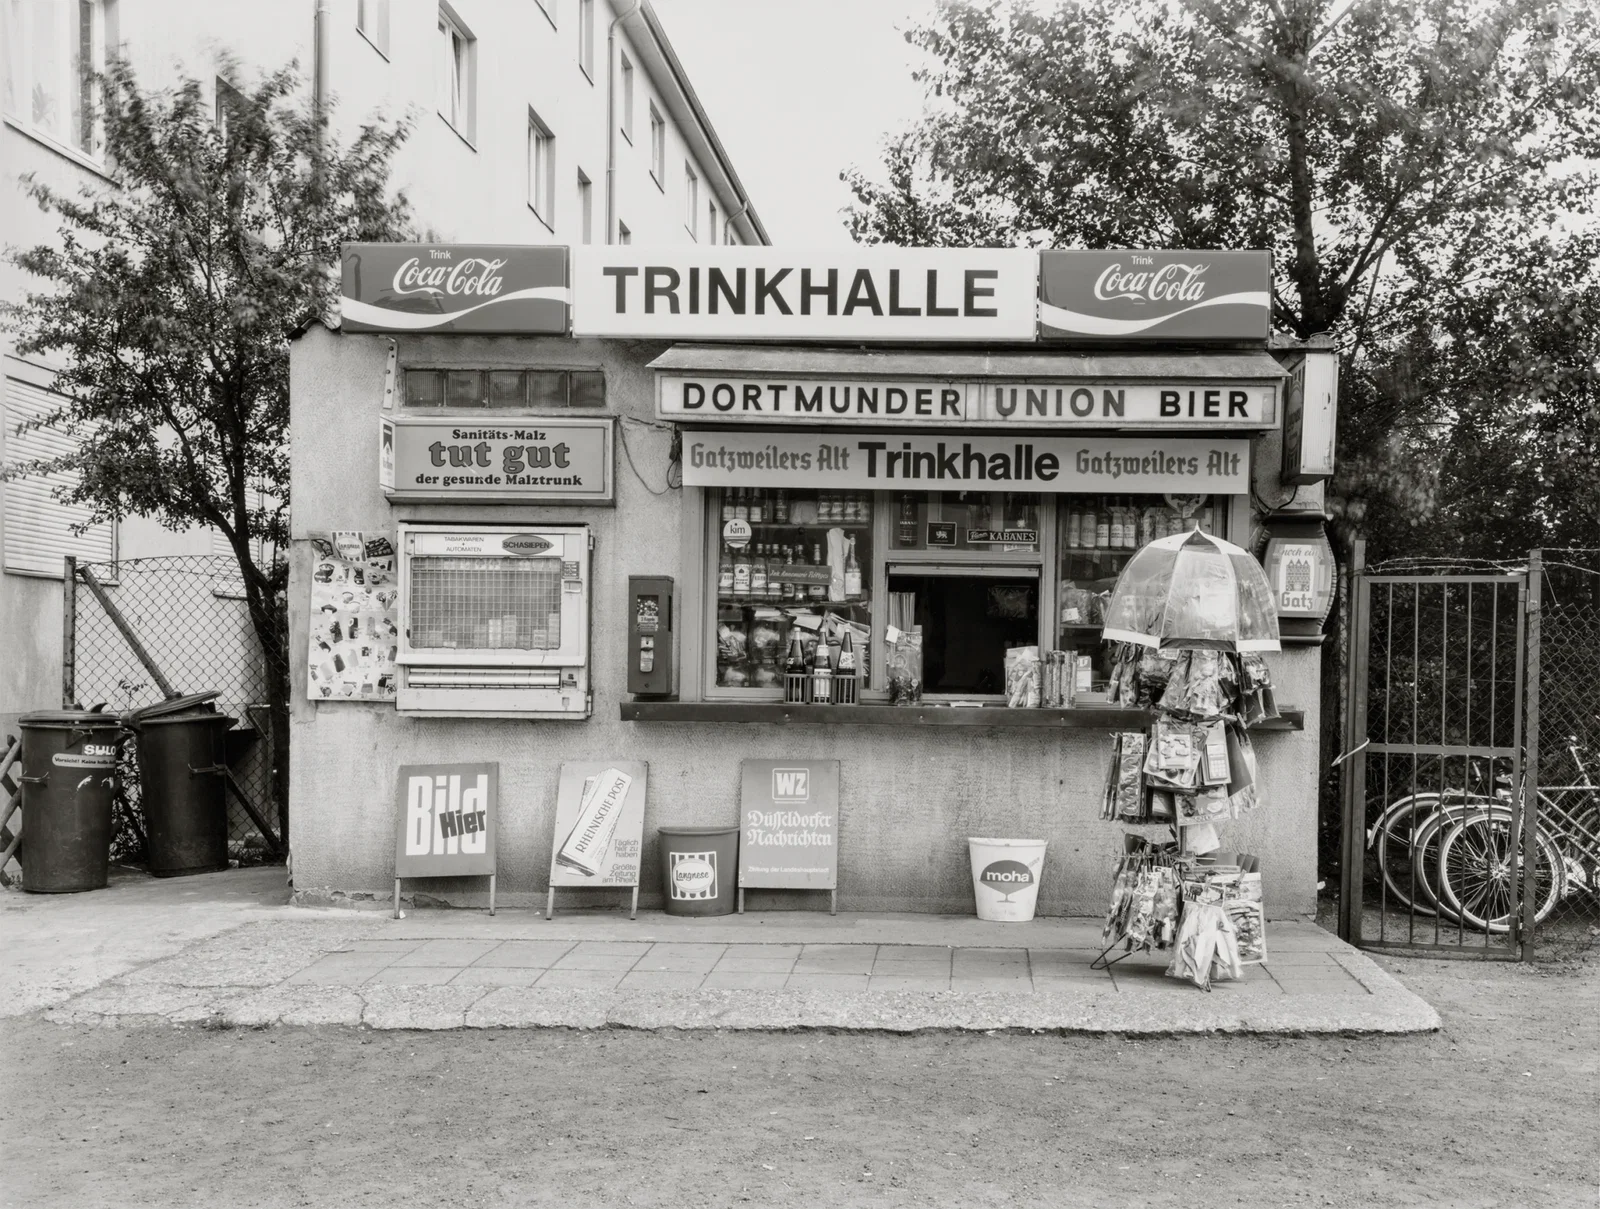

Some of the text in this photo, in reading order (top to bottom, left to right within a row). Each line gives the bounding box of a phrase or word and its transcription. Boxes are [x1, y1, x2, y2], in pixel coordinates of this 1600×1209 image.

[429, 250, 451, 259] Trink
[1131, 256, 1153, 265] Trink
[393, 257, 508, 295] Coca-Cola
[1094, 263, 1211, 301] Coca-Cola
[602, 266, 998, 317] TRINKHALLE
[682, 382, 1249, 417] DORTMUNDER UNION BIER
[452, 429, 547, 440] Sanitäts-Malz
[428, 441, 570, 474] tut gut
[690, 441, 1241, 481] Gatzweilers Alt Trinkhalle Gatzweilers Alt
[415, 473, 583, 487] der gesunde Malztrunk
[730, 523, 746, 534] kim
[502, 541, 550, 549] SCHASIEPEN
[1281, 592, 1313, 610] Gatz
[775, 772, 806, 795] WZ
[405, 774, 489, 856] Bild
[439, 809, 486, 839] Hier
[575, 777, 627, 853] RHEINISCHE POST
[614, 839, 639, 847] Täglich
[747, 829, 832, 848] Nachrichten
[609, 870, 637, 878] Zeitung
[612, 863, 637, 871] Größte
[676, 869, 709, 882] Langnese
[986, 870, 1030, 882] moha
